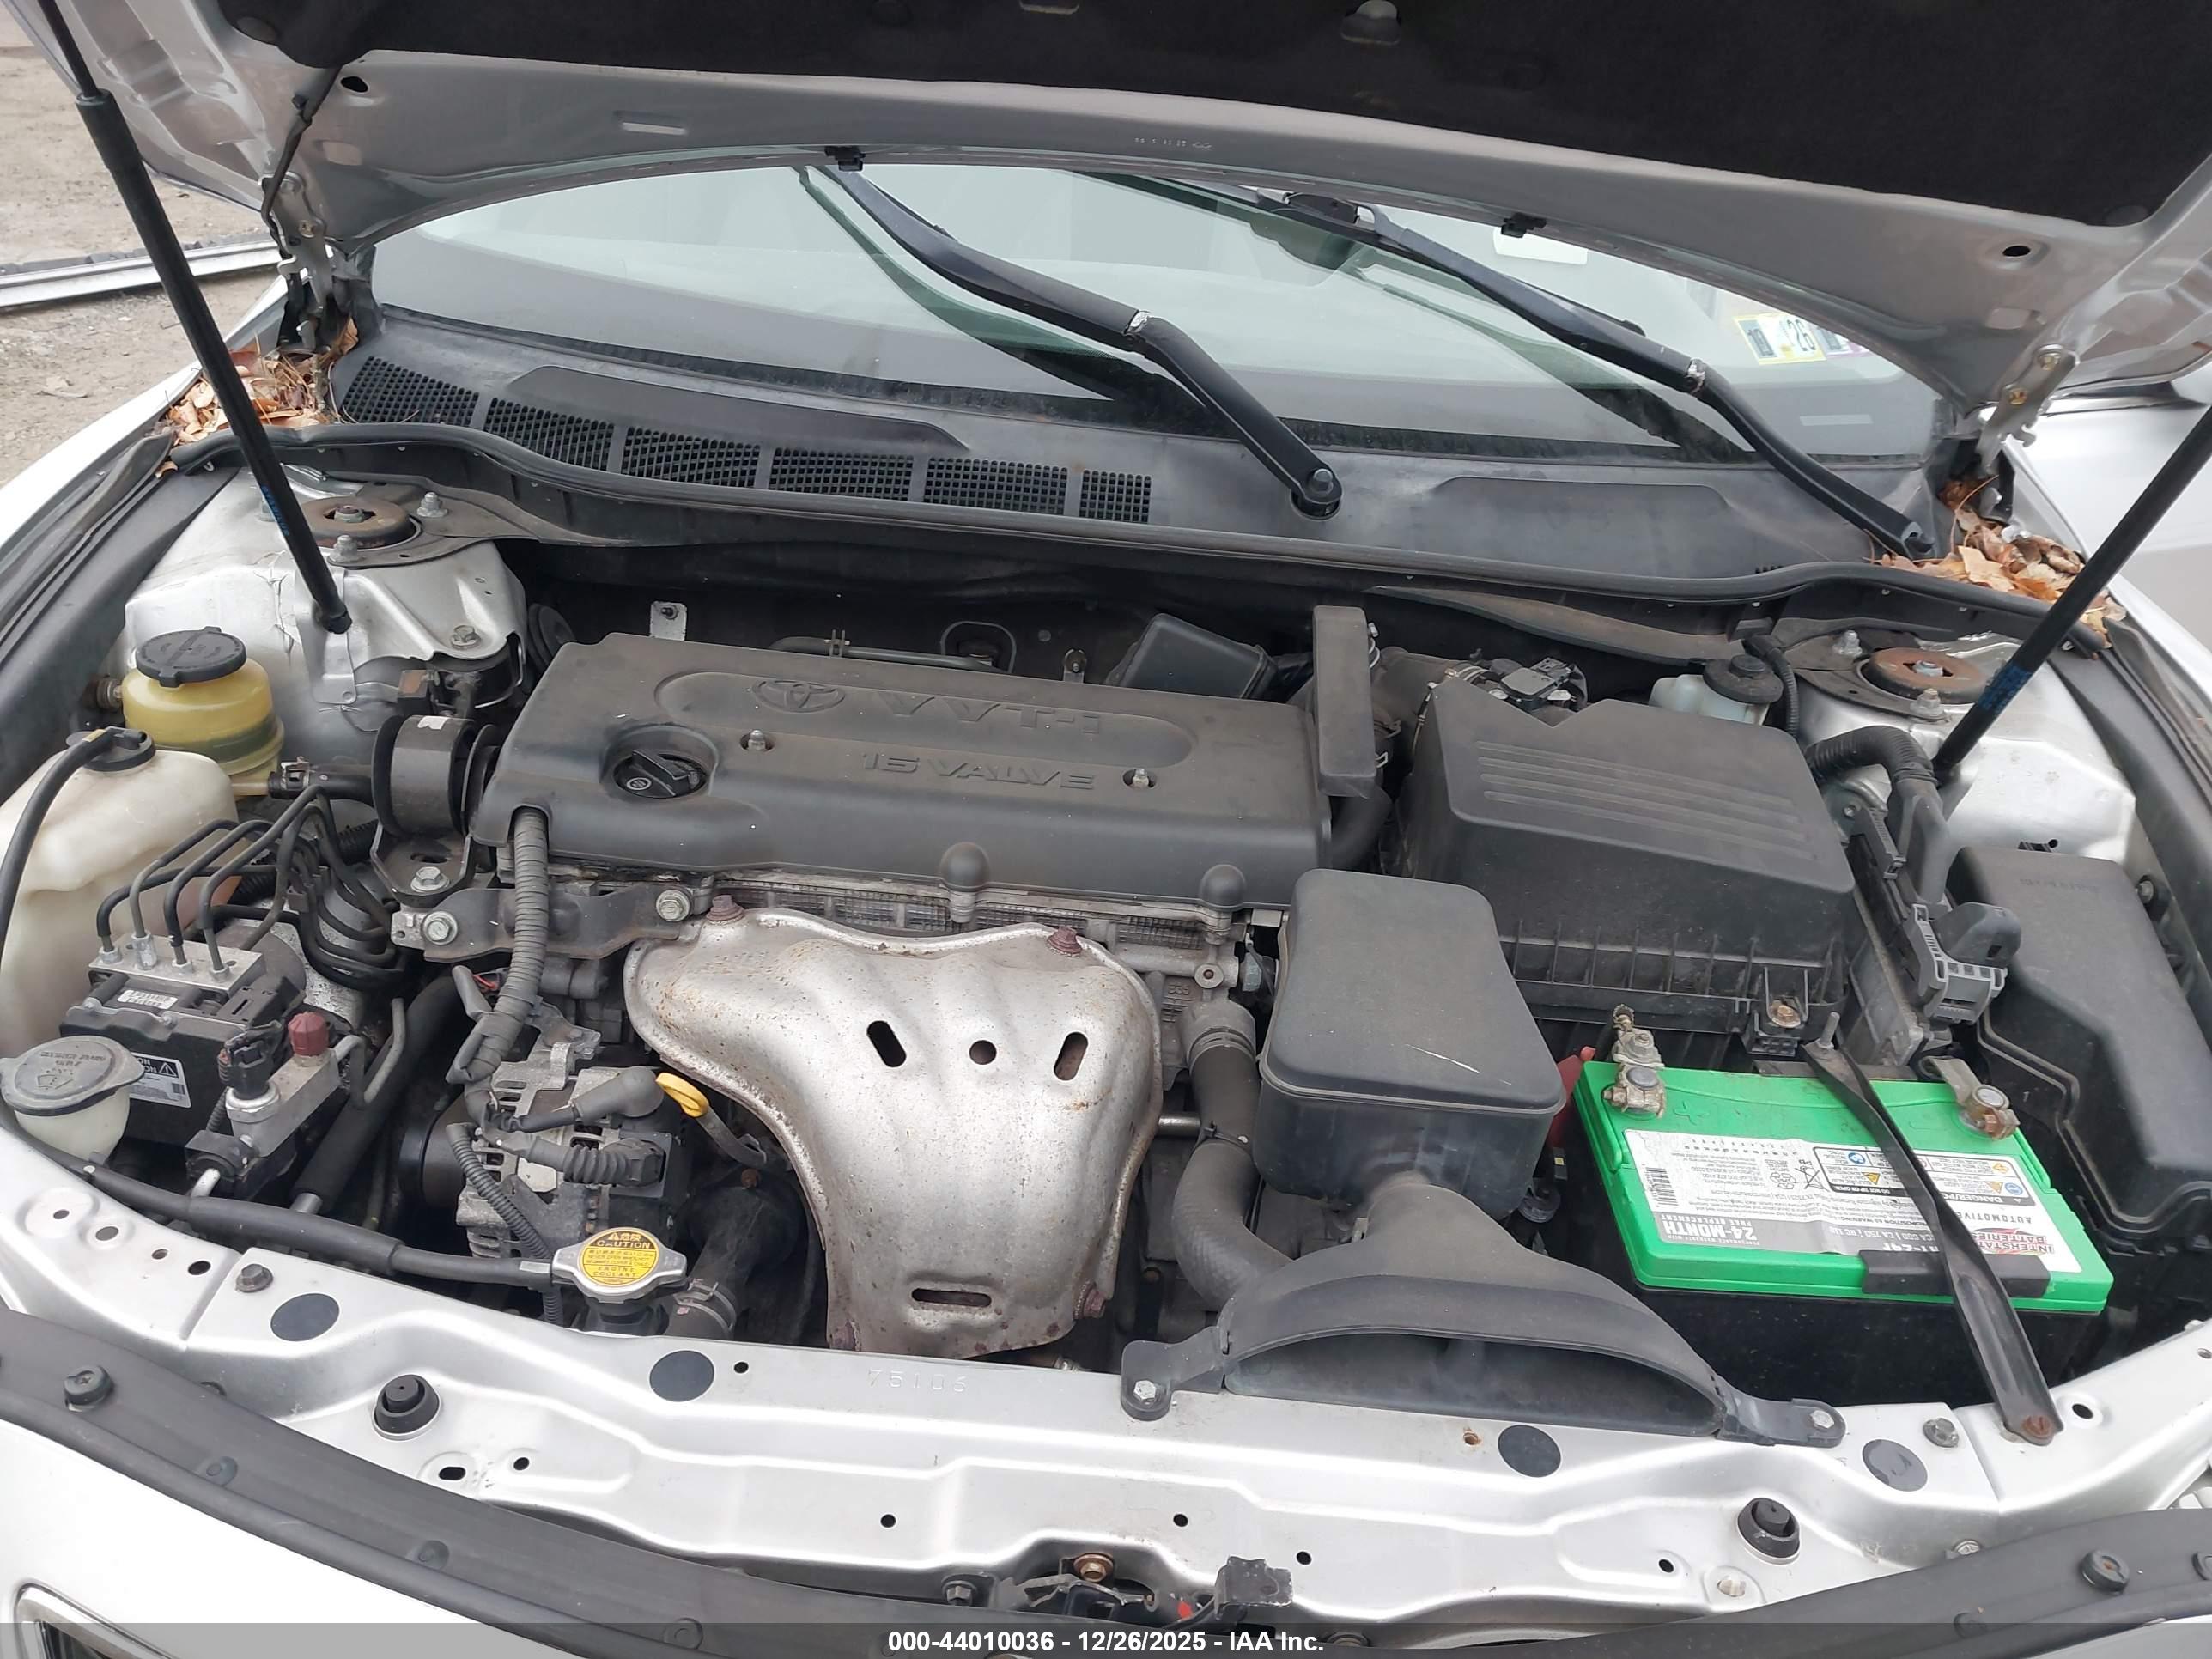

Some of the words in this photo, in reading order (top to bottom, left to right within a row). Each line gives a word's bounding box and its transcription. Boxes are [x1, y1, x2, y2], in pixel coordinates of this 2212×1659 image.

[863, 752, 920, 773] 16
[927, 757, 1096, 790] VALVE
[1957, 1212, 2032, 1224] AUTOMOTIVE
[1662, 1220, 1759, 1241] 24-MONTH
[597, 1240, 651, 1249] CAUTION
[1978, 1241, 2054, 1254] INTERSTAT
[868, 1368, 968, 1392] 75106
